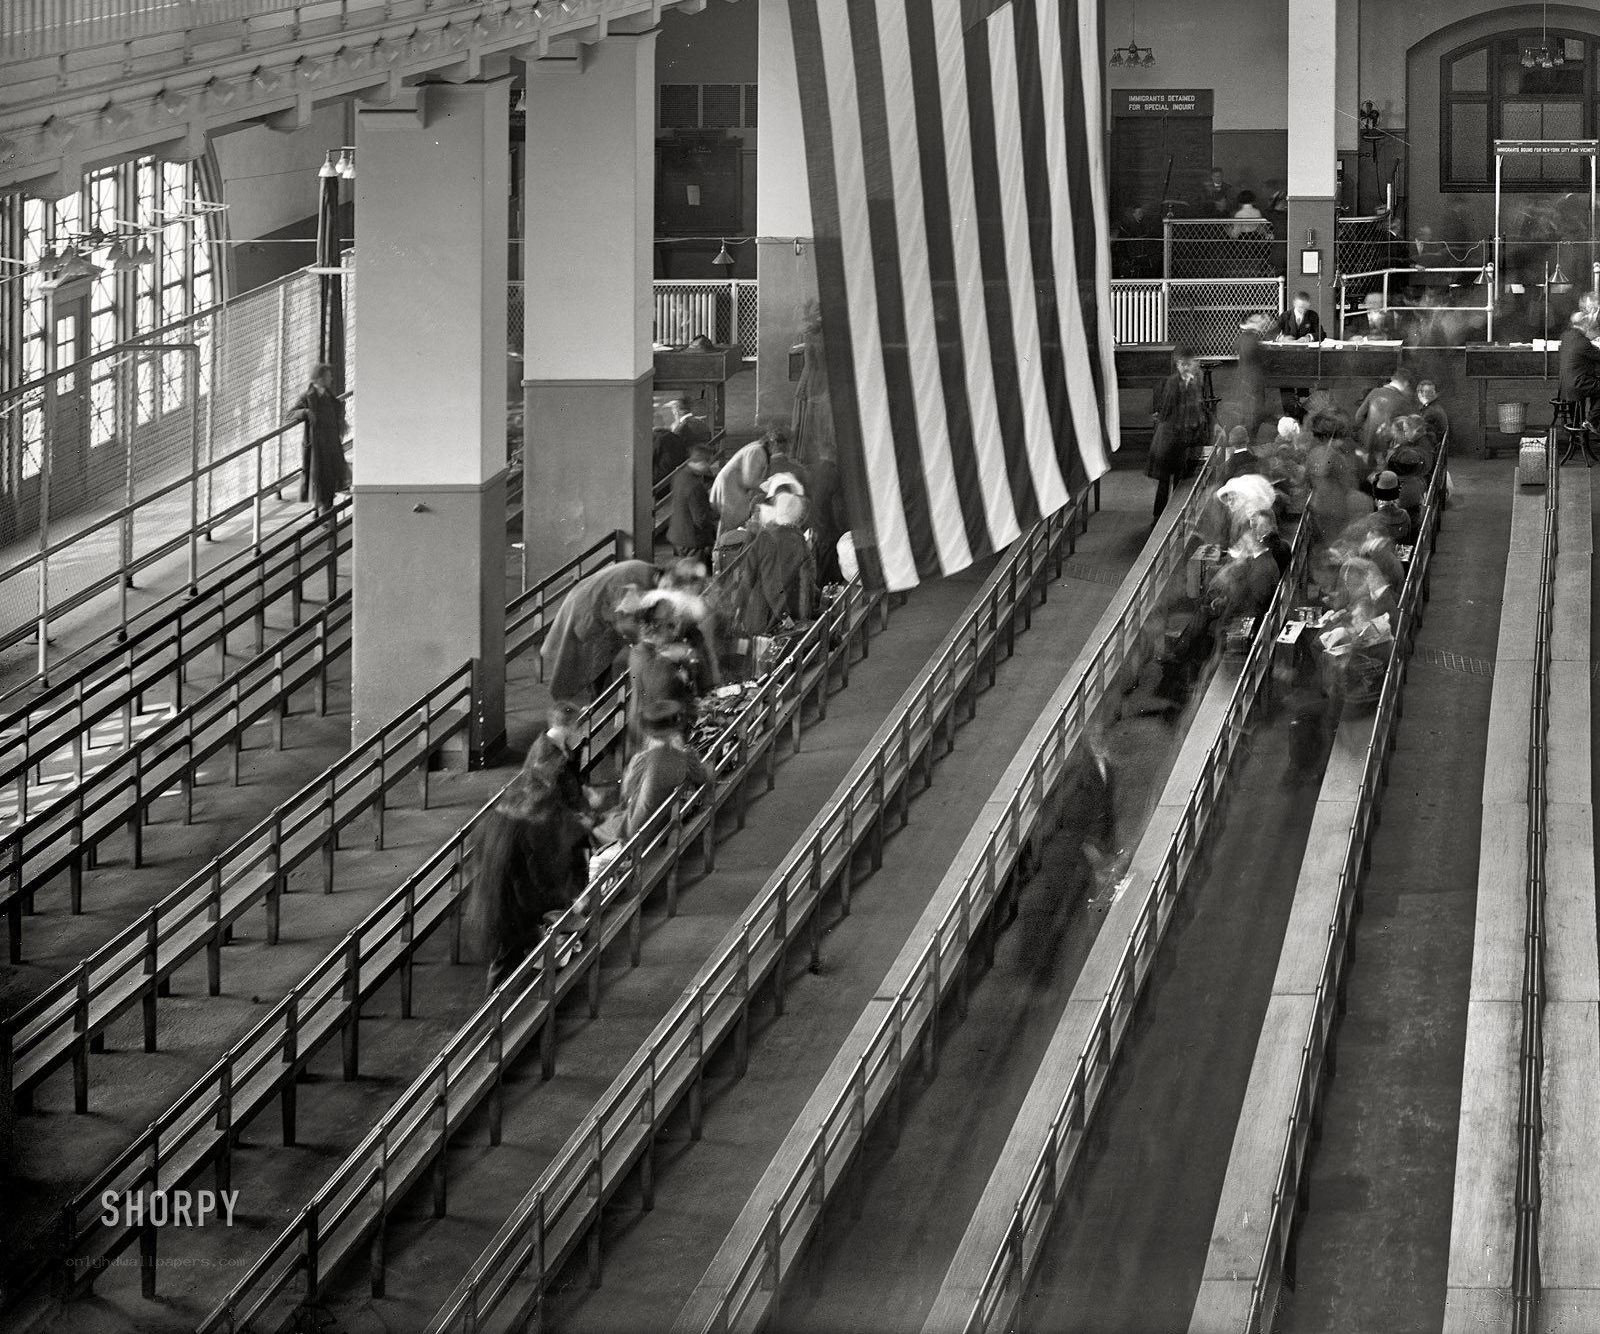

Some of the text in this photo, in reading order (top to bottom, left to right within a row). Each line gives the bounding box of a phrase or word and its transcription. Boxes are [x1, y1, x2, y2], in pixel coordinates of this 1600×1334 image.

[1128, 103, 1195, 111] FOR SPECIAL INQUIRY
